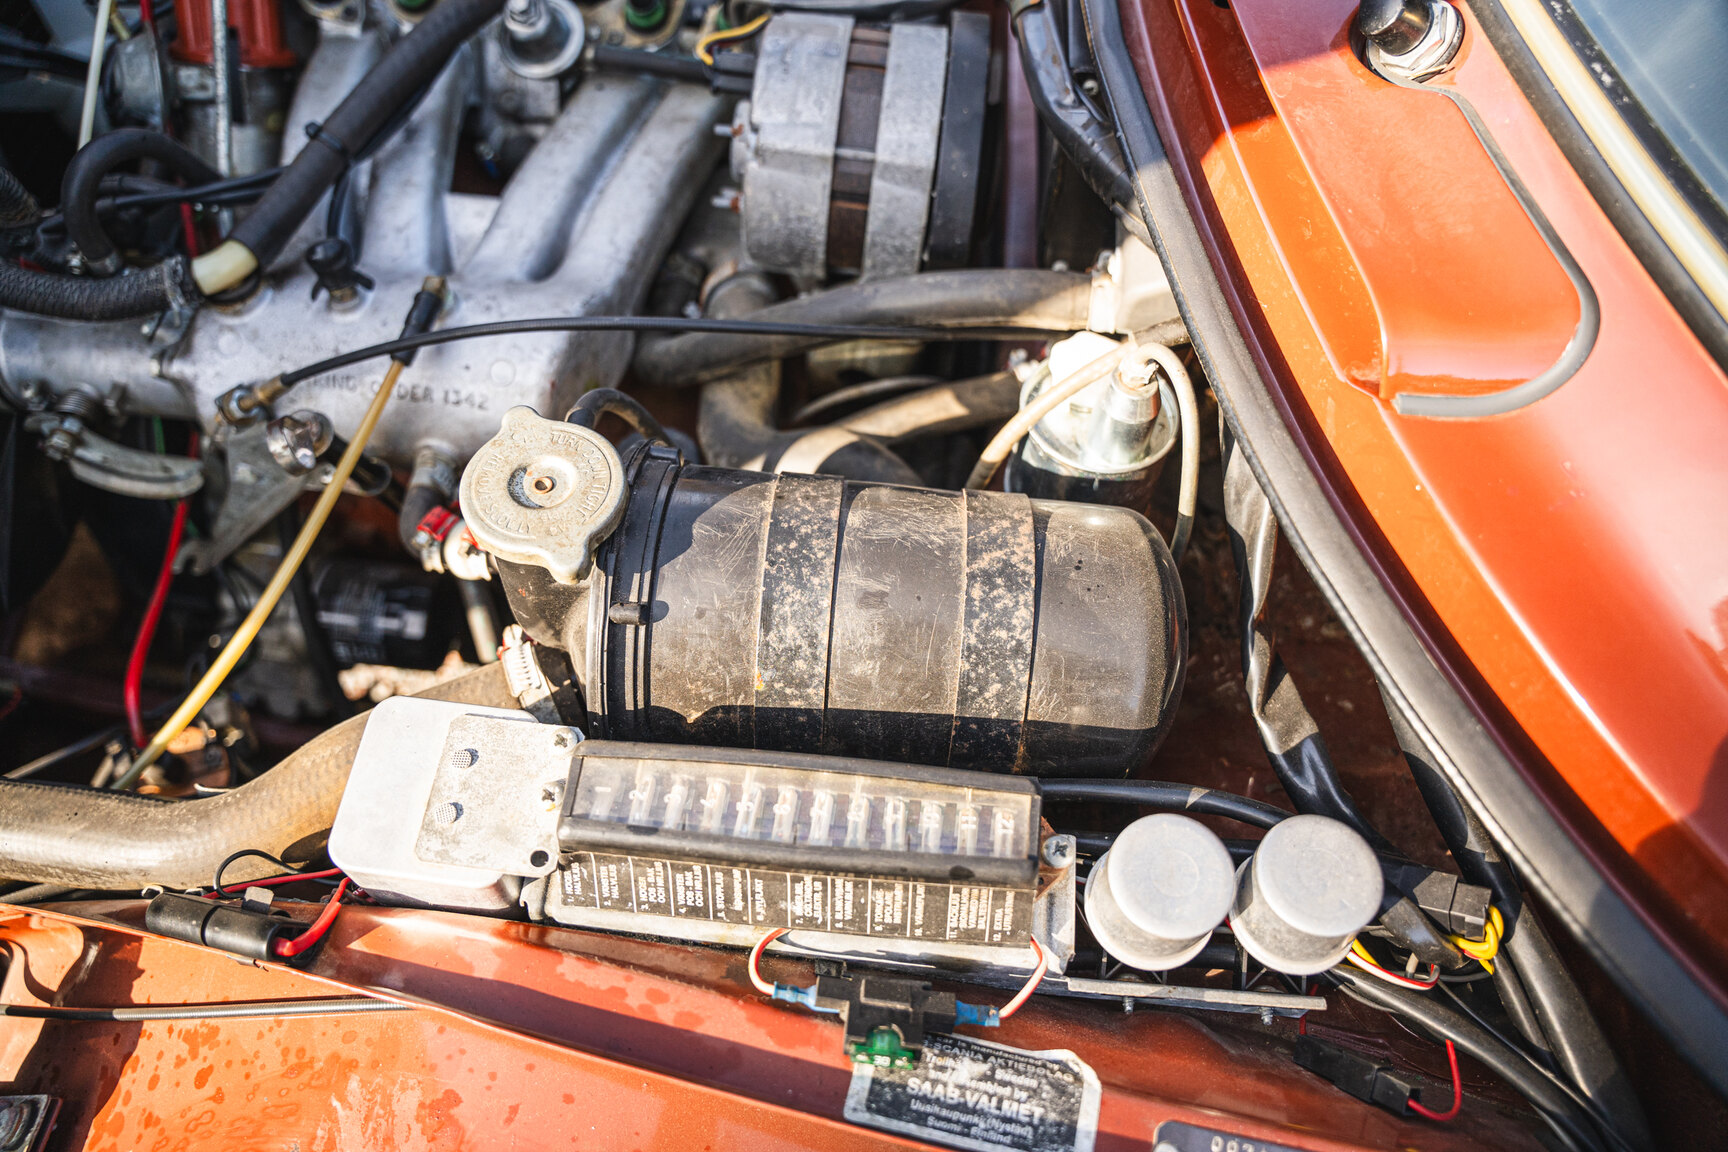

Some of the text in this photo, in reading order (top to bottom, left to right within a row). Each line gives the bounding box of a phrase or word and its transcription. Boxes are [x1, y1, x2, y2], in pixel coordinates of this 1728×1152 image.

[371, 380, 433, 403] ODER
[551, 431, 583, 451] TURN
[577, 481, 606, 518] TIGHT
[608, 864, 619, 898] HALVLJUS
[657, 887, 666, 904] OCH
[695, 891, 704, 907] OCH
[994, 908, 1003, 930] EXTRA
[987, 1055, 1075, 1083] AKTIEBOLAG
[994, 1068, 1039, 1089] Sweden
[906, 1077, 1046, 1125] SAAB-VALMET
[926, 1116, 963, 1133] Suomi
